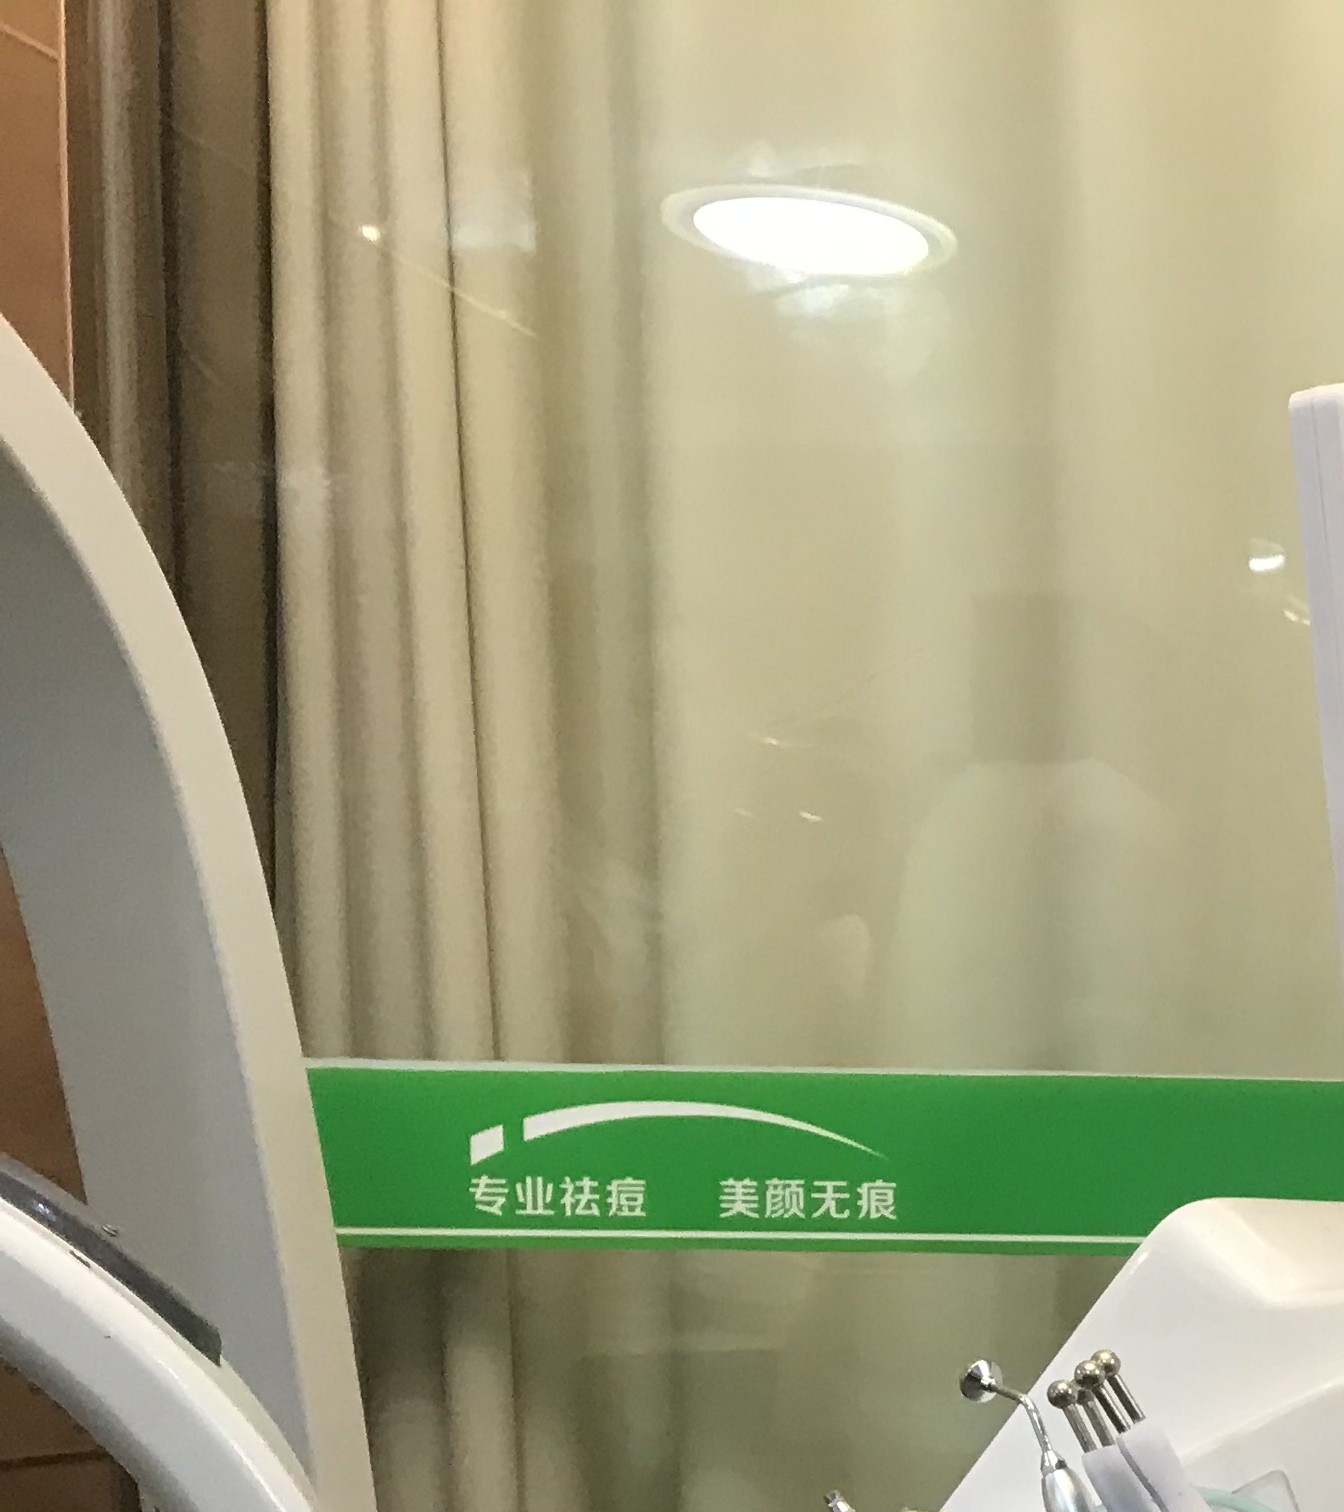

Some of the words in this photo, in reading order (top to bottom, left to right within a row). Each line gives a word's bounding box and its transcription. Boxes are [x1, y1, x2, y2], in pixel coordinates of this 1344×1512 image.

[469, 1175, 647, 1217] 专业祛痘
[718, 1176, 898, 1221] 美颜无痕
